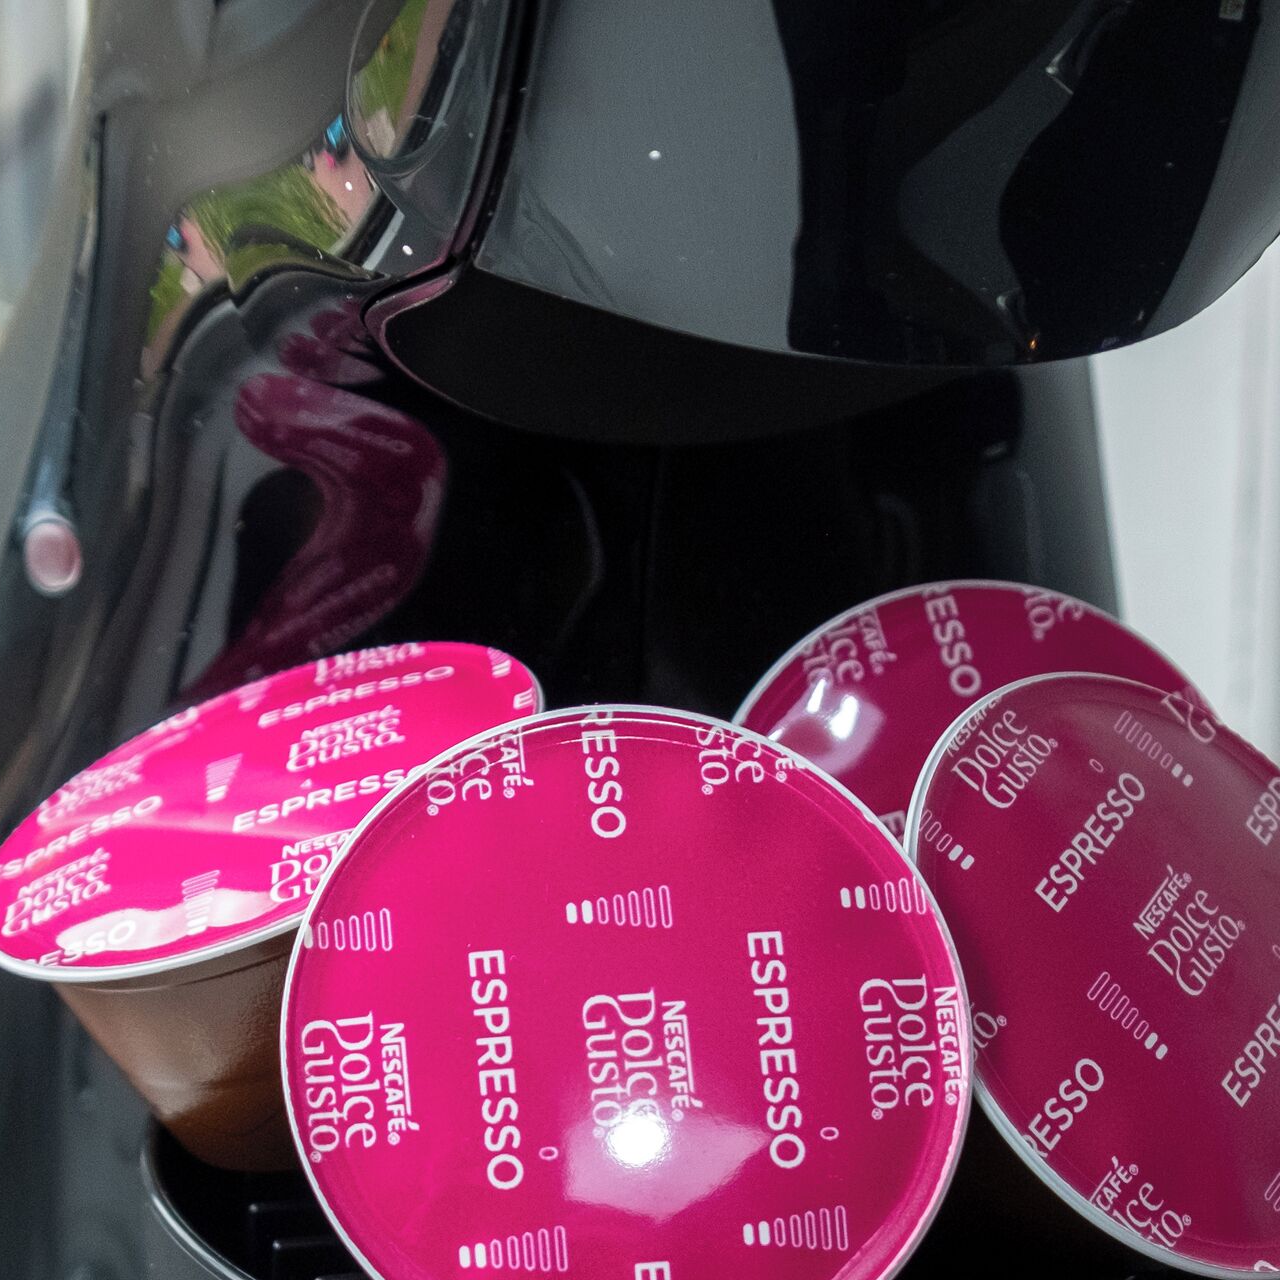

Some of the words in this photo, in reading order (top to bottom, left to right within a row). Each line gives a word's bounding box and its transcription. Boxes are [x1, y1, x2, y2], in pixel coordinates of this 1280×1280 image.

[257, 666, 455, 729] ESPRESSO
[951, 709, 1028, 792] Dolce
[232, 763, 427, 834] ESPRESS
[281, 827, 356, 860] NESCA
[1033, 772, 1146, 914] ESPRESSO
[1147, 889, 1219, 977] Dolce
[335, 1009, 381, 1149] Dolce
[467, 948, 524, 1191] ESPRESSO
[747, 930, 806, 1170] ESPRESSO
[891, 972, 937, 1107] Dolce
